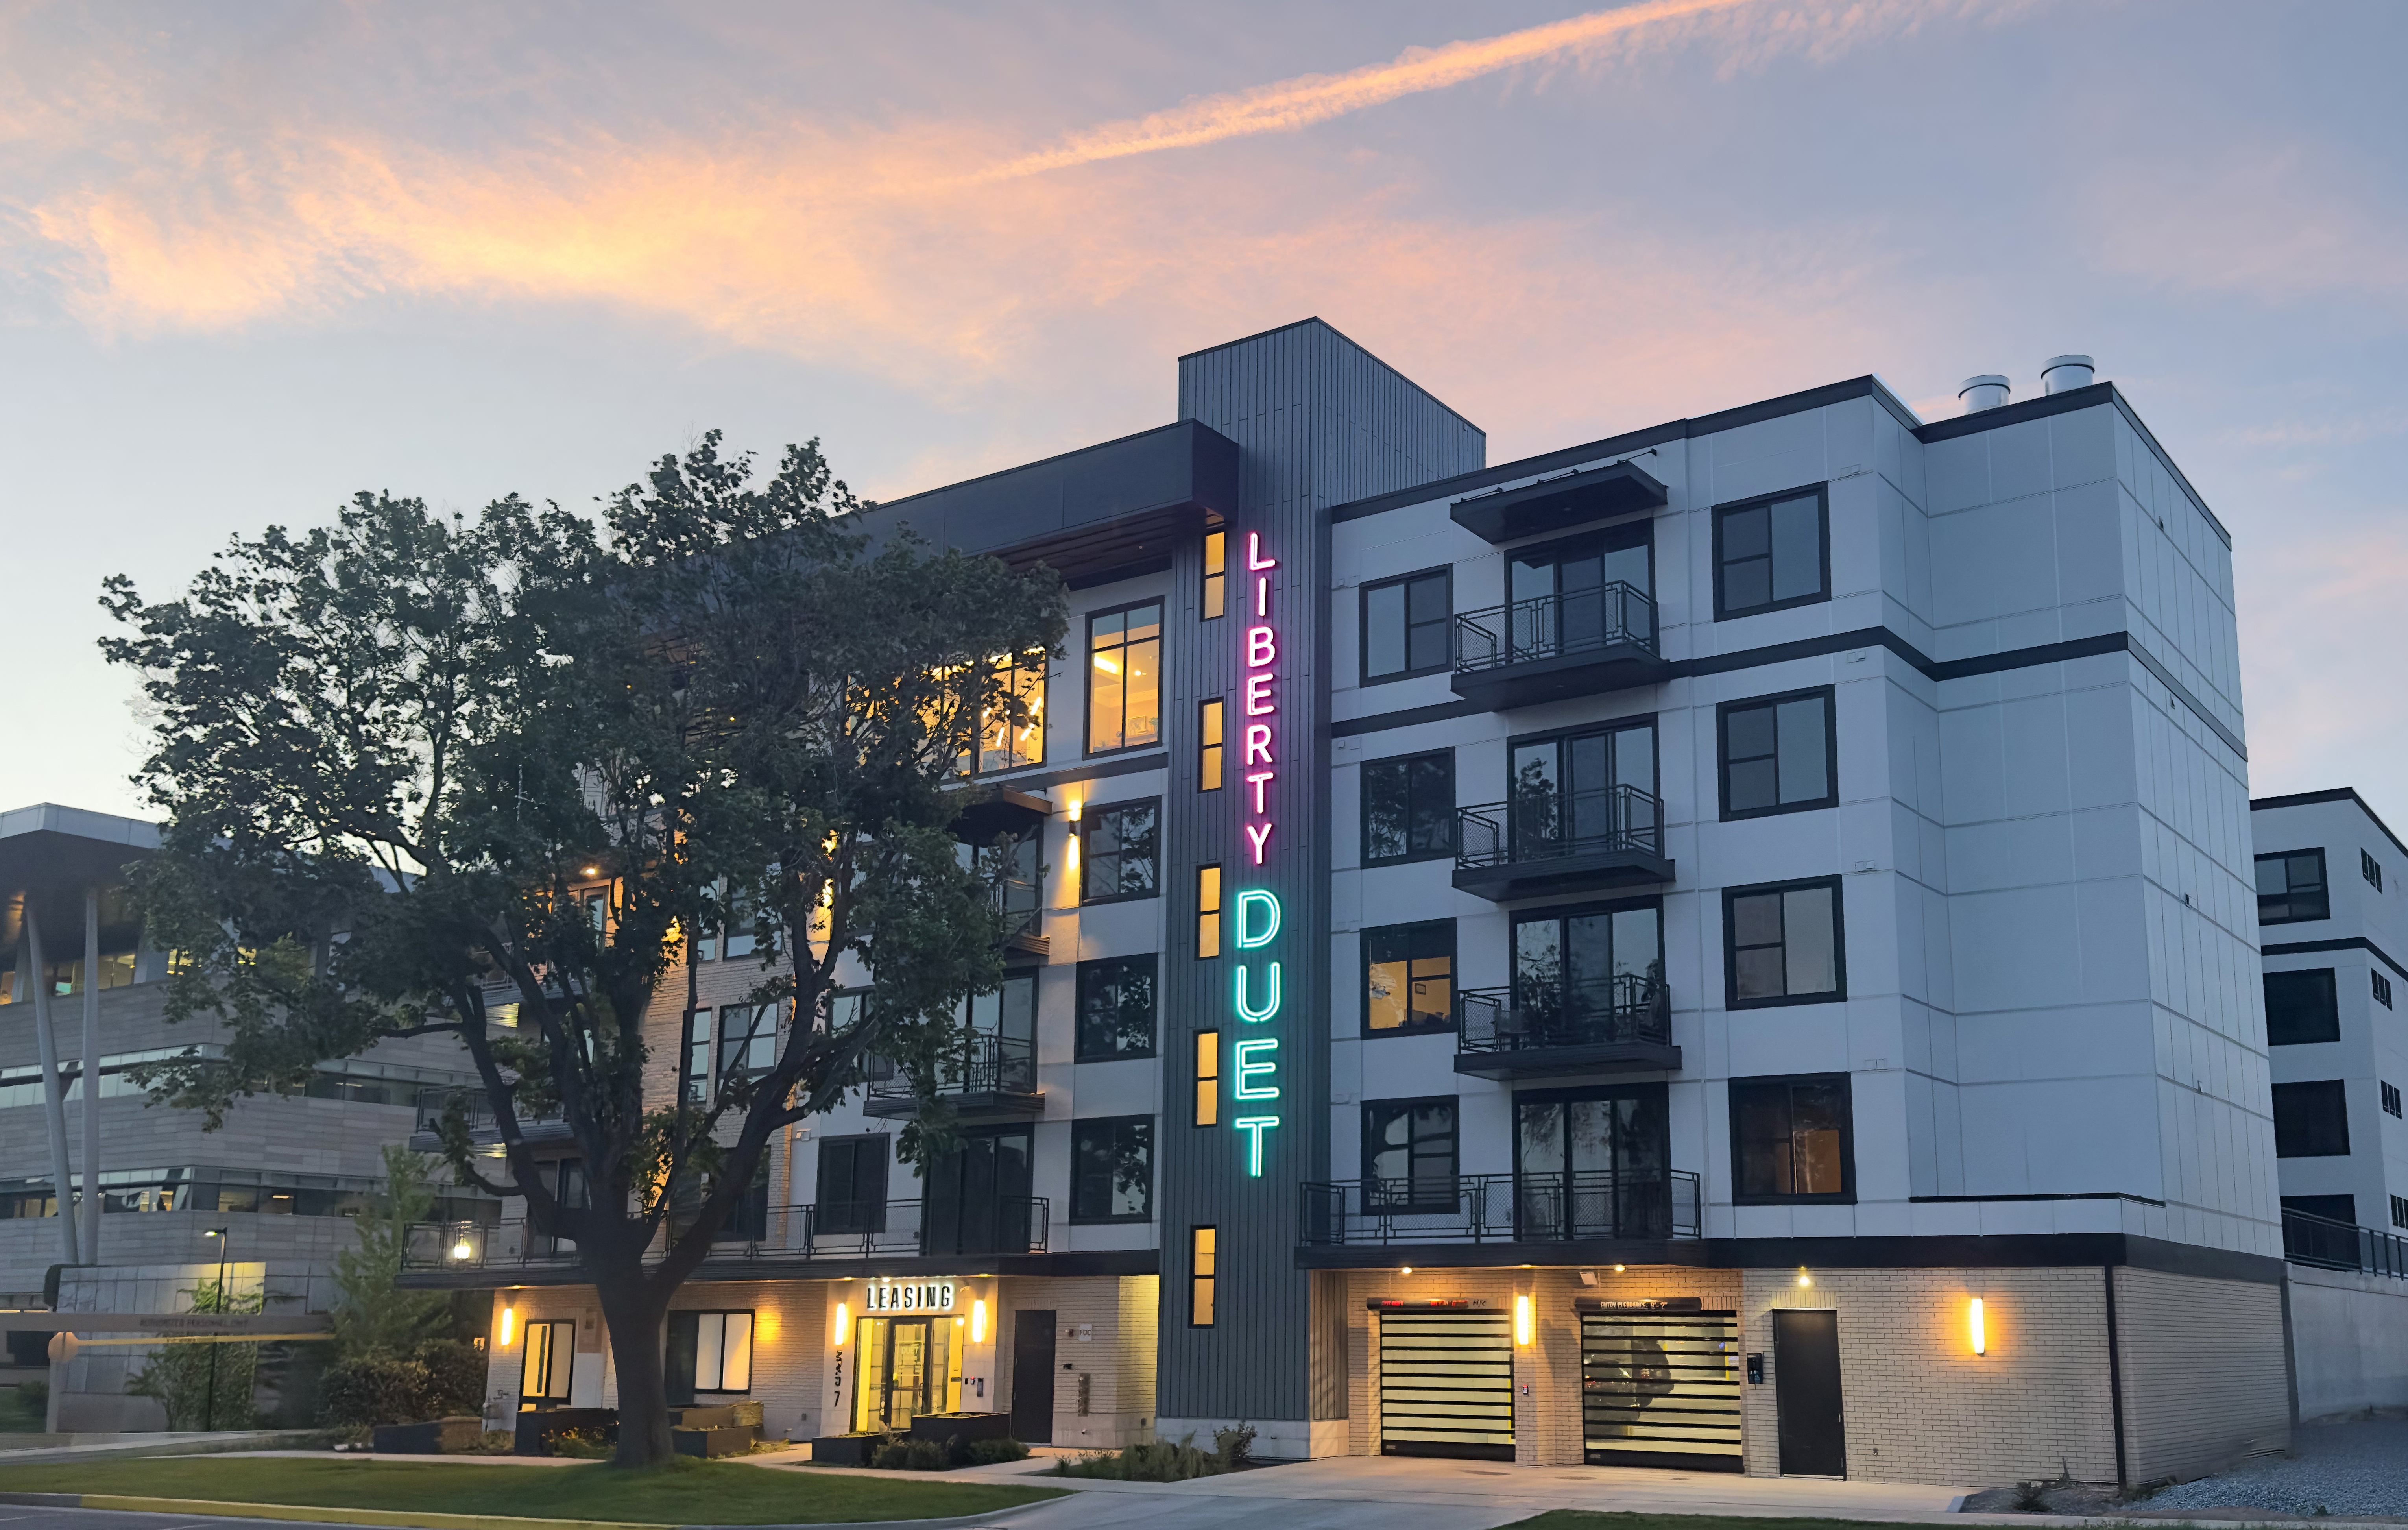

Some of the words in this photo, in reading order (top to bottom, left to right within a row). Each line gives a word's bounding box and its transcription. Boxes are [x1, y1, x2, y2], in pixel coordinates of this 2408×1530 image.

[1246, 532, 1276, 865] LIBERTY
[1235, 889, 1281, 1177] DUET
[867, 1286, 951, 1309] LEASING
